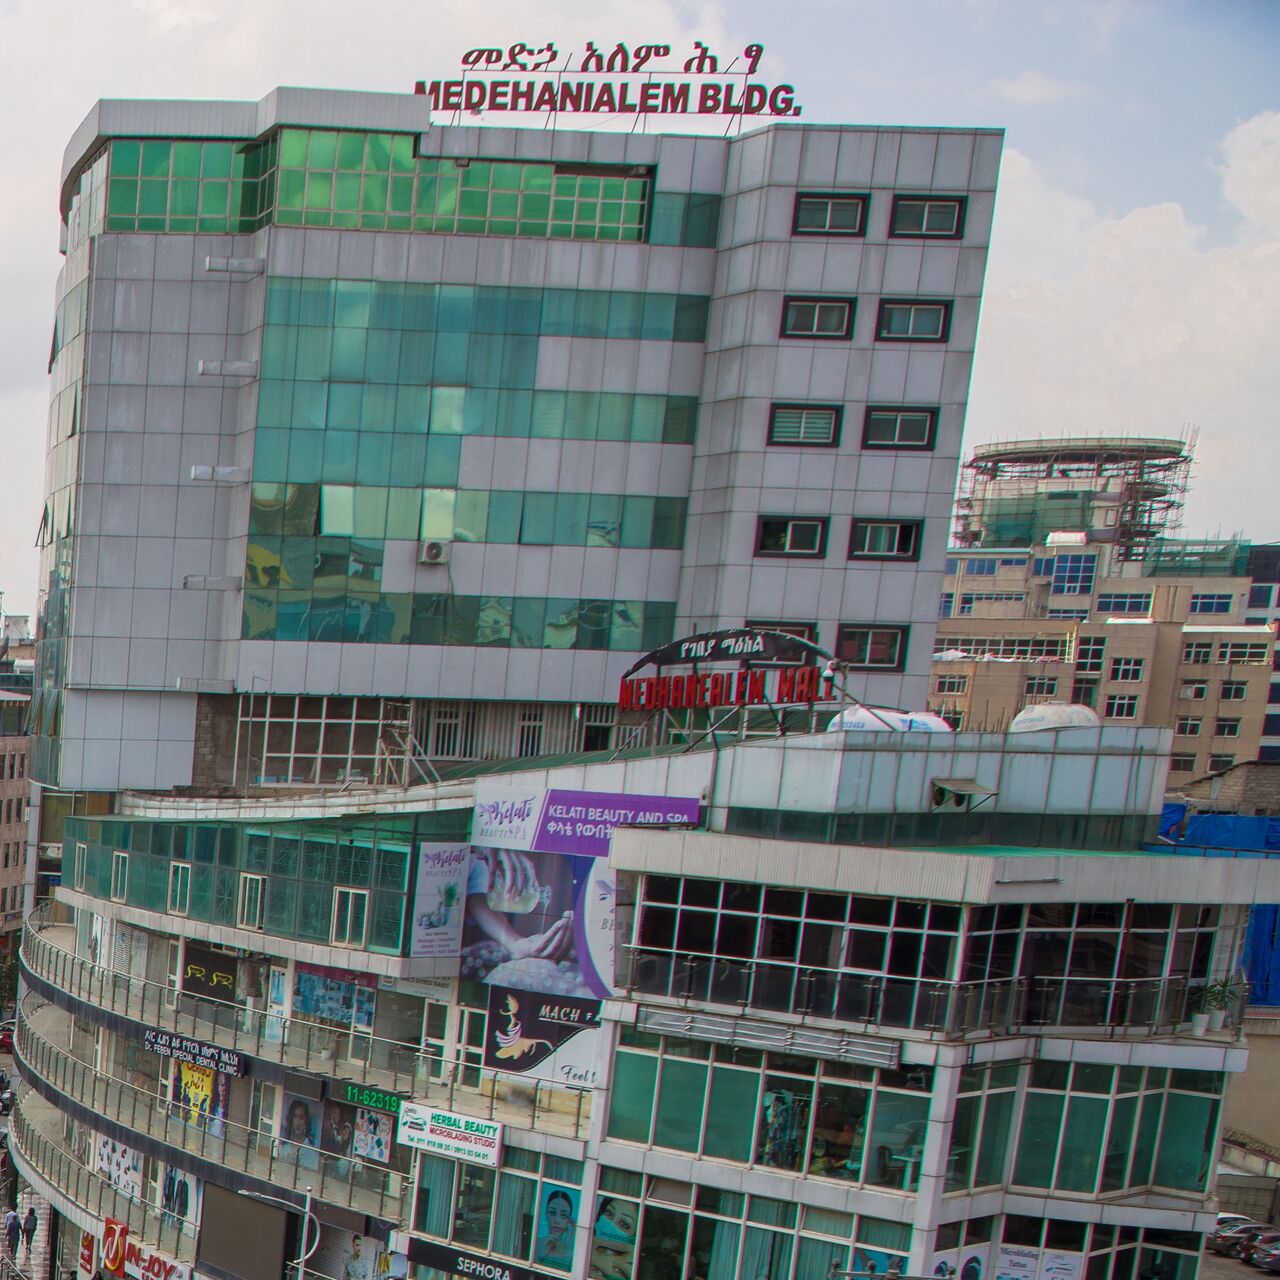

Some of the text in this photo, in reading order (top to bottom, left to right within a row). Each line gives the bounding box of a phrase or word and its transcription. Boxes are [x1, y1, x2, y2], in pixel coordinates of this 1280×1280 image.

[414, 80, 803, 116] MEDEHANIALEM BLDG.
[548, 805, 585, 819] KELATI
[588, 807, 634, 823] BEAUTY
[637, 811, 663, 823] AND
[539, 1004, 581, 1022] MACH
[153, 1044, 172, 1057] FEBEN
[172, 1049, 195, 1064] SPECIAL
[196, 1056, 218, 1070] DENTAL
[218, 1063, 239, 1077] CLINIC
[346, 1085, 402, 1114] 11-62319
[431, 1113, 463, 1130] HERBAL
[464, 1120, 498, 1137] BEAUTY
[430, 1126, 496, 1149] MICROBLADING STUDIO
